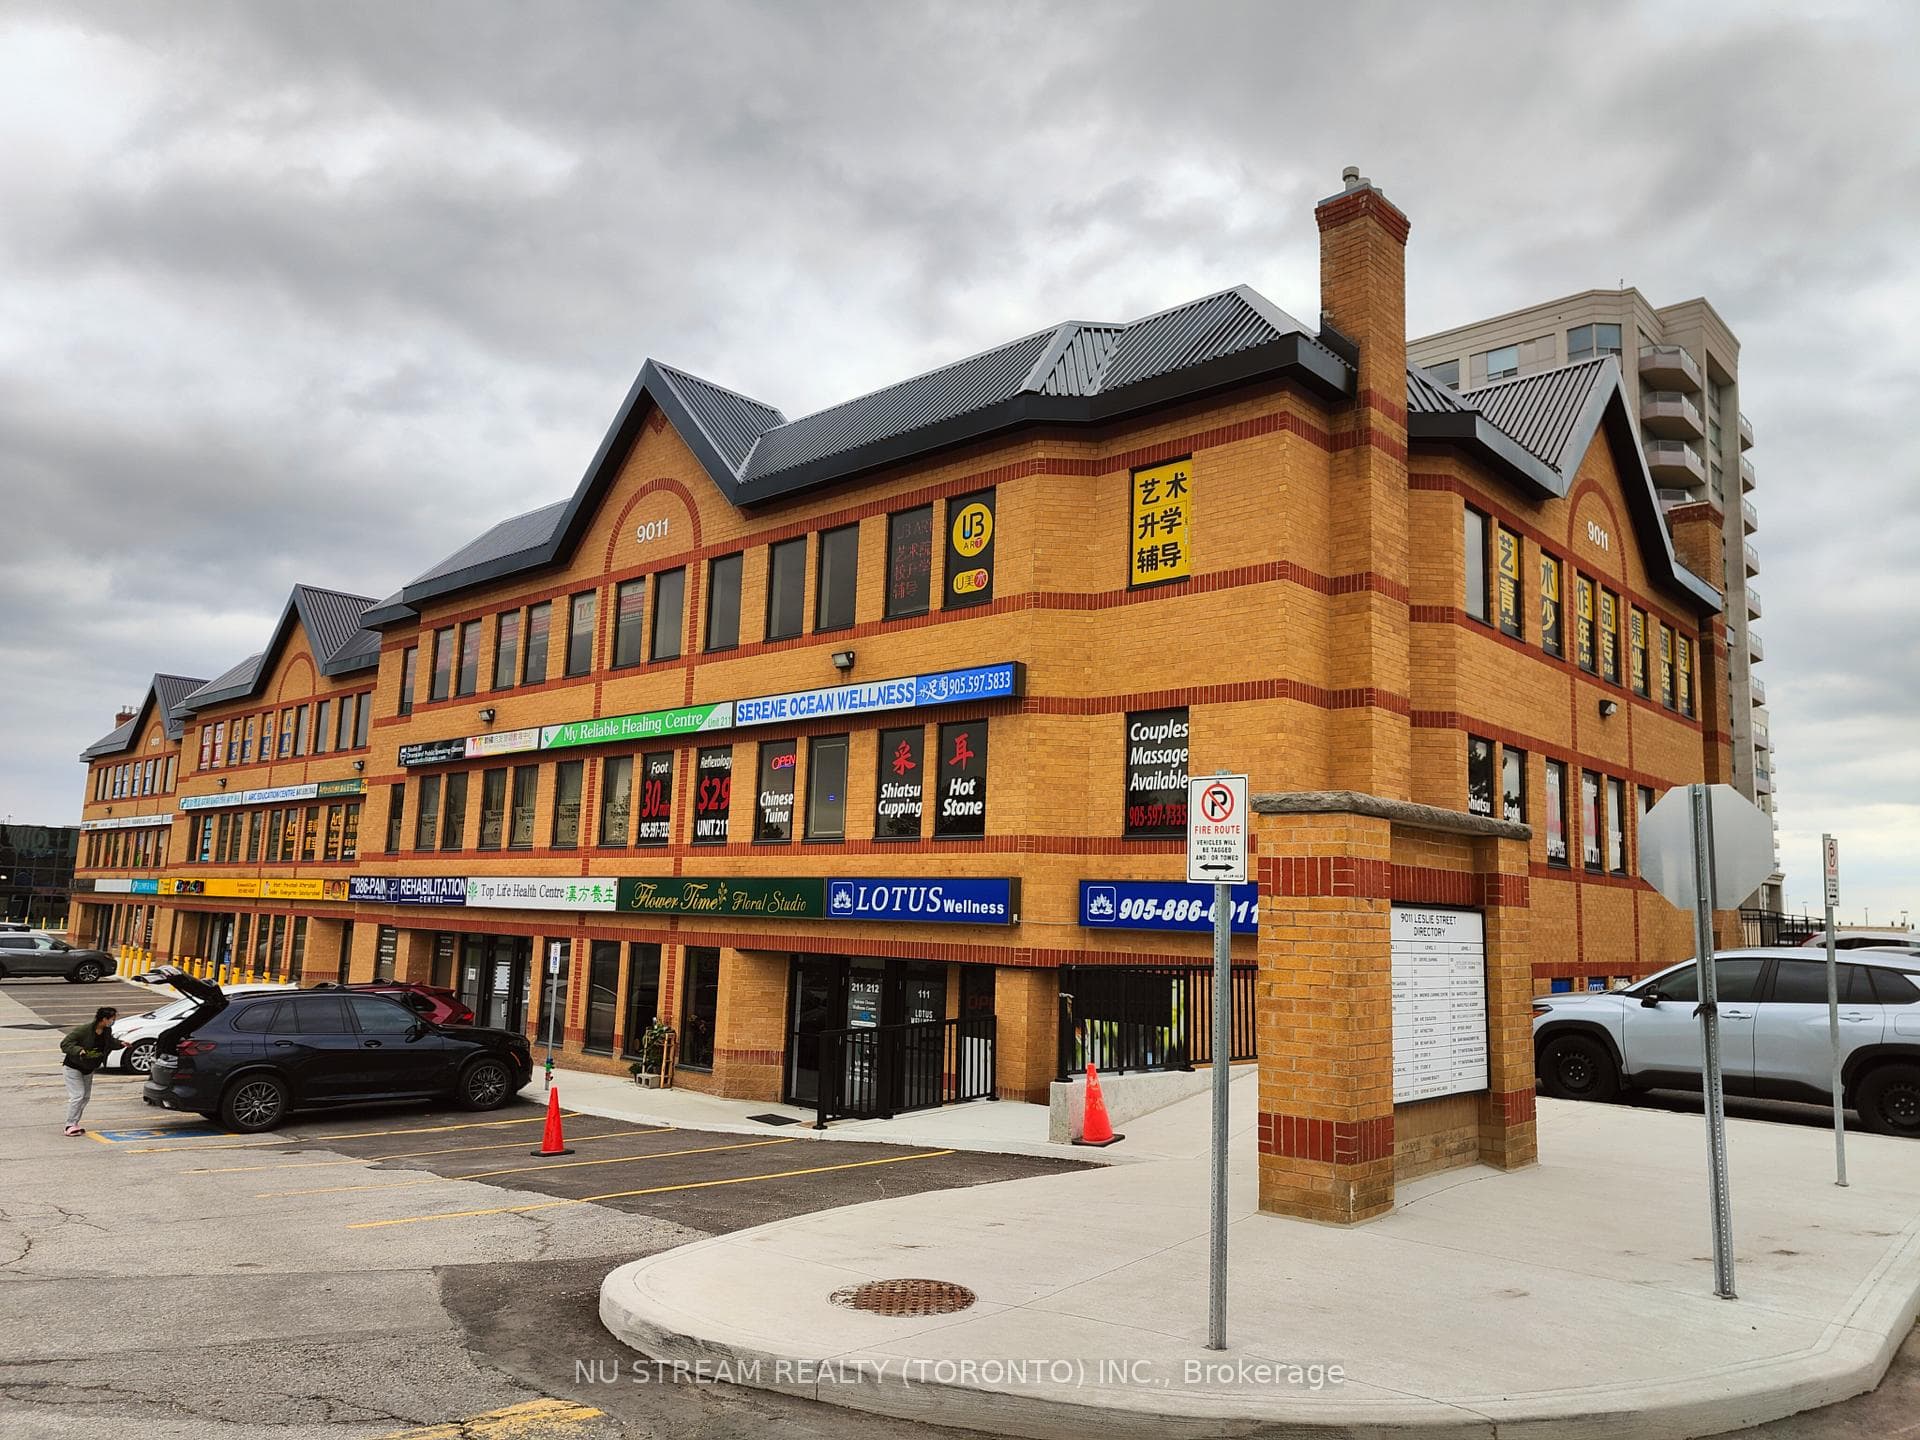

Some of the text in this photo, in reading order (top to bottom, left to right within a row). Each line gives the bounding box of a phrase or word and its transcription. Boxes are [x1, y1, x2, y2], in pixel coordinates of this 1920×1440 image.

[1139, 472, 1187, 505] 艺术
[637, 518, 669, 543] 9011
[1138, 506, 1182, 540] 升学
[1587, 521, 1610, 552] 9011
[1137, 541, 1181, 573] 辅导
[949, 671, 1011, 696] 905.597.5833
[738, 682, 915, 723] SERENE OCEAN WELLNESS
[563, 712, 703, 744] My Reliable Healing Centre
[1130, 719, 1188, 744] Couples
[651, 761, 669, 774] Foot
[700, 754, 731, 770] Reflexology
[771, 754, 796, 770] OPEN
[1130, 746, 1188, 769] Massage
[949, 777, 976, 797] Hot
[1130, 769, 1188, 792] Available
[642, 779, 661, 818] 30
[698, 776, 731, 815] $29
[760, 790, 793, 807] Chinese
[880, 783, 921, 799] Shiatsu
[765, 808, 789, 823] Tuina
[878, 799, 922, 819] Cupping
[943, 800, 983, 817] Stone
[1130, 805, 1187, 827] 905-597-7335
[697, 819, 729, 837] UNIT 211
[1195, 825, 1241, 835] FIRE ROUTE
[400, 878, 466, 896] REHABILITATION
[481, 884, 565, 900] Top Life Health Centre
[565, 885, 616, 904] 漢方養生
[631, 882, 679, 910] Flower
[732, 890, 768, 911] Floral
[767, 889, 806, 913] Studio
[856, 886, 1005, 915] LOTUS Wellness
[1400, 912, 1457, 925] 9011 LESLIE STREET
[1413, 926, 1446, 937] DIRECTORY
[851, 983, 880, 994] 211 212
[917, 990, 931, 999] 111
[915, 1009, 933, 1019] LOTUS
